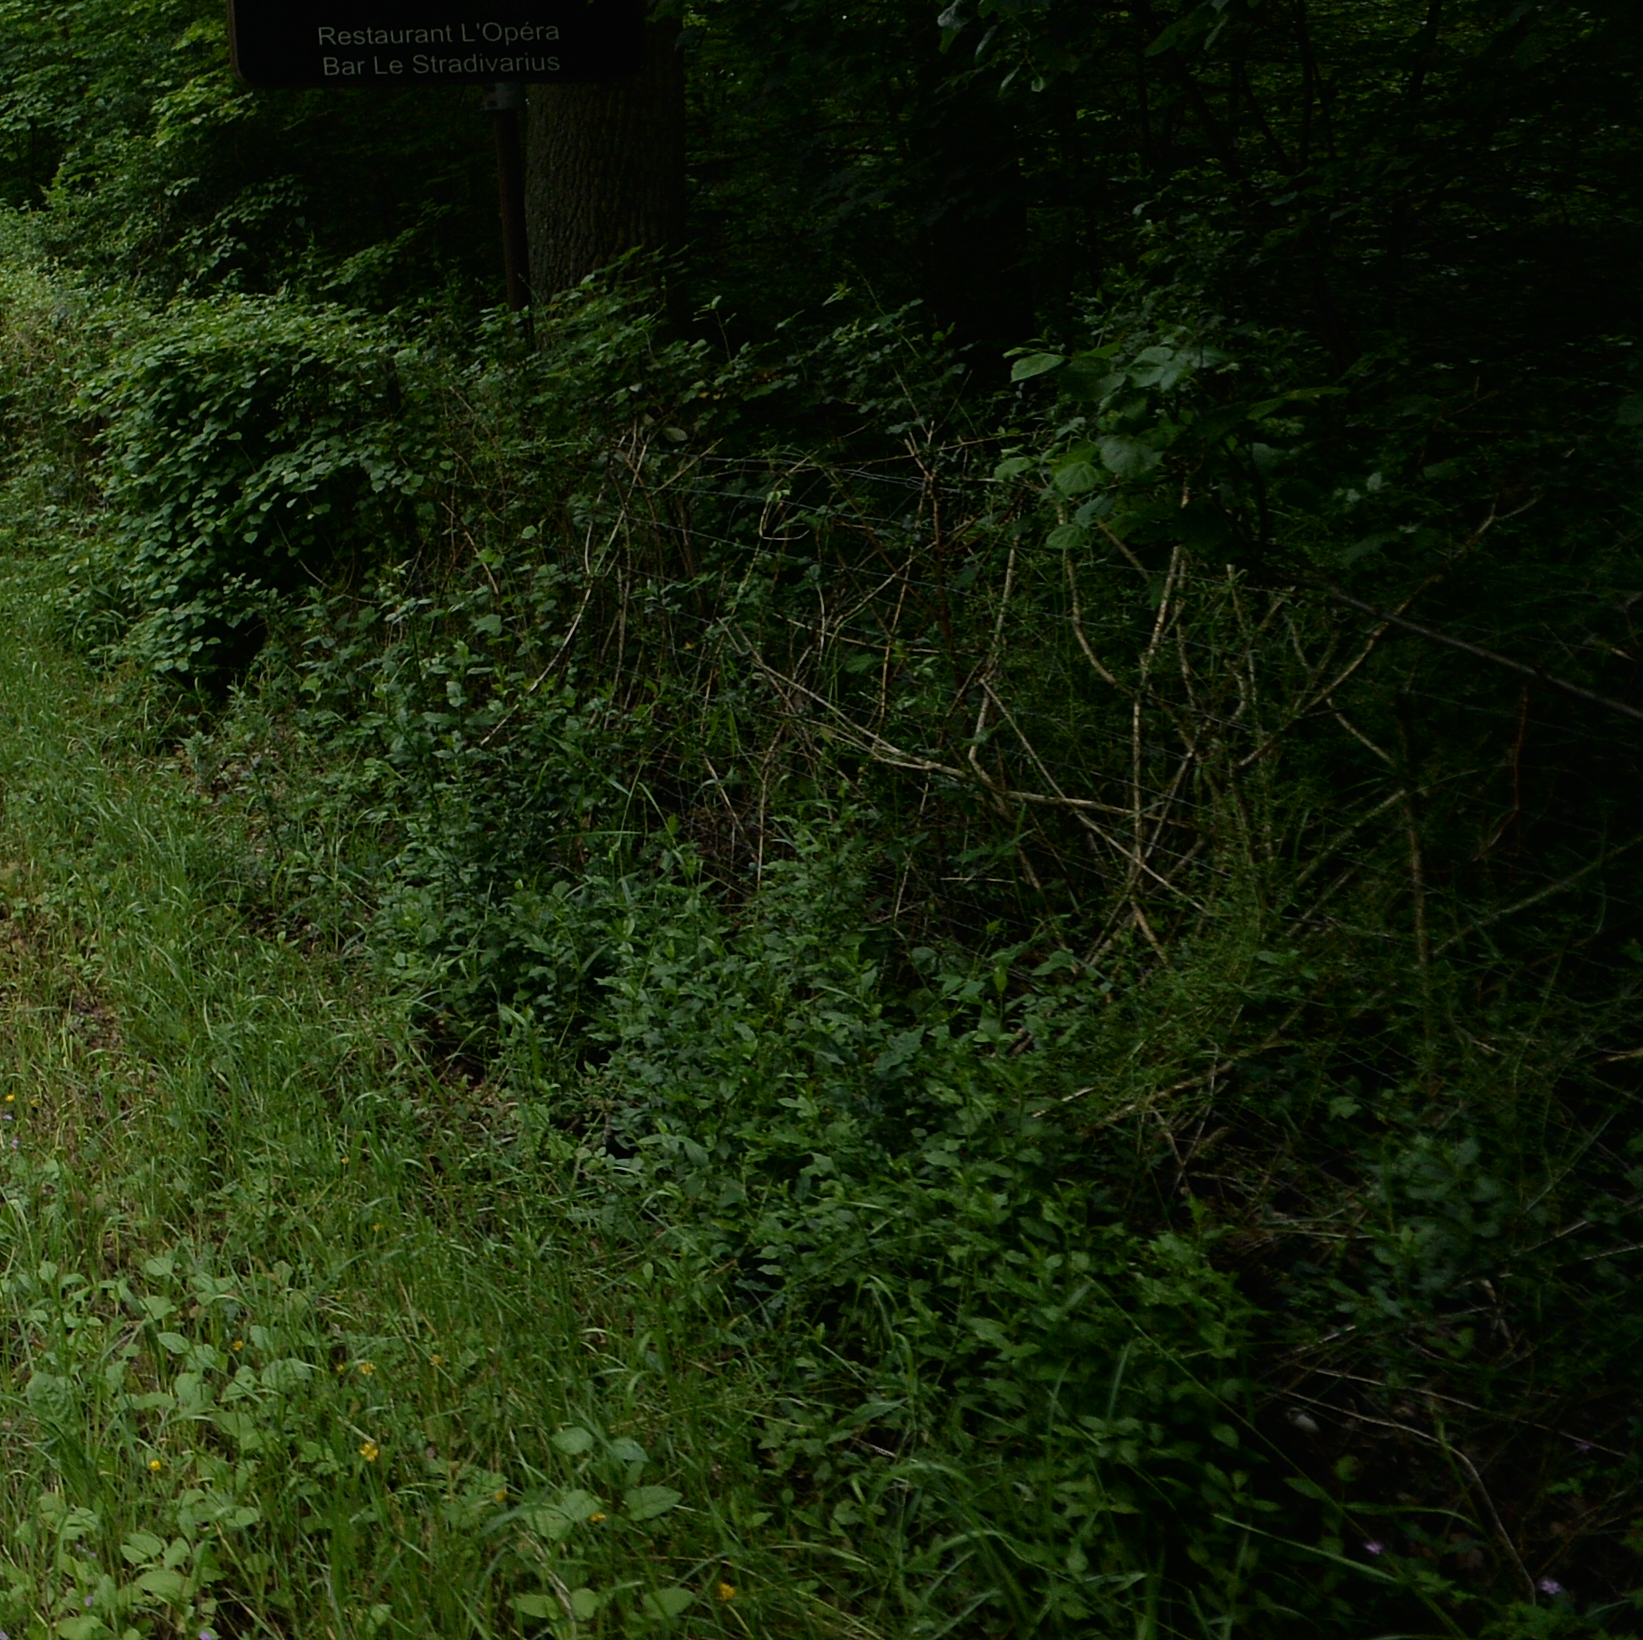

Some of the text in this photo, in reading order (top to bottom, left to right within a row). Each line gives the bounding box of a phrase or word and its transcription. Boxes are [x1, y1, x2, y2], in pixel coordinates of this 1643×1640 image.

[317, 21, 560, 48] Restaurant L'Opéra
[322, 52, 561, 77] Bar Le Stradivarius
